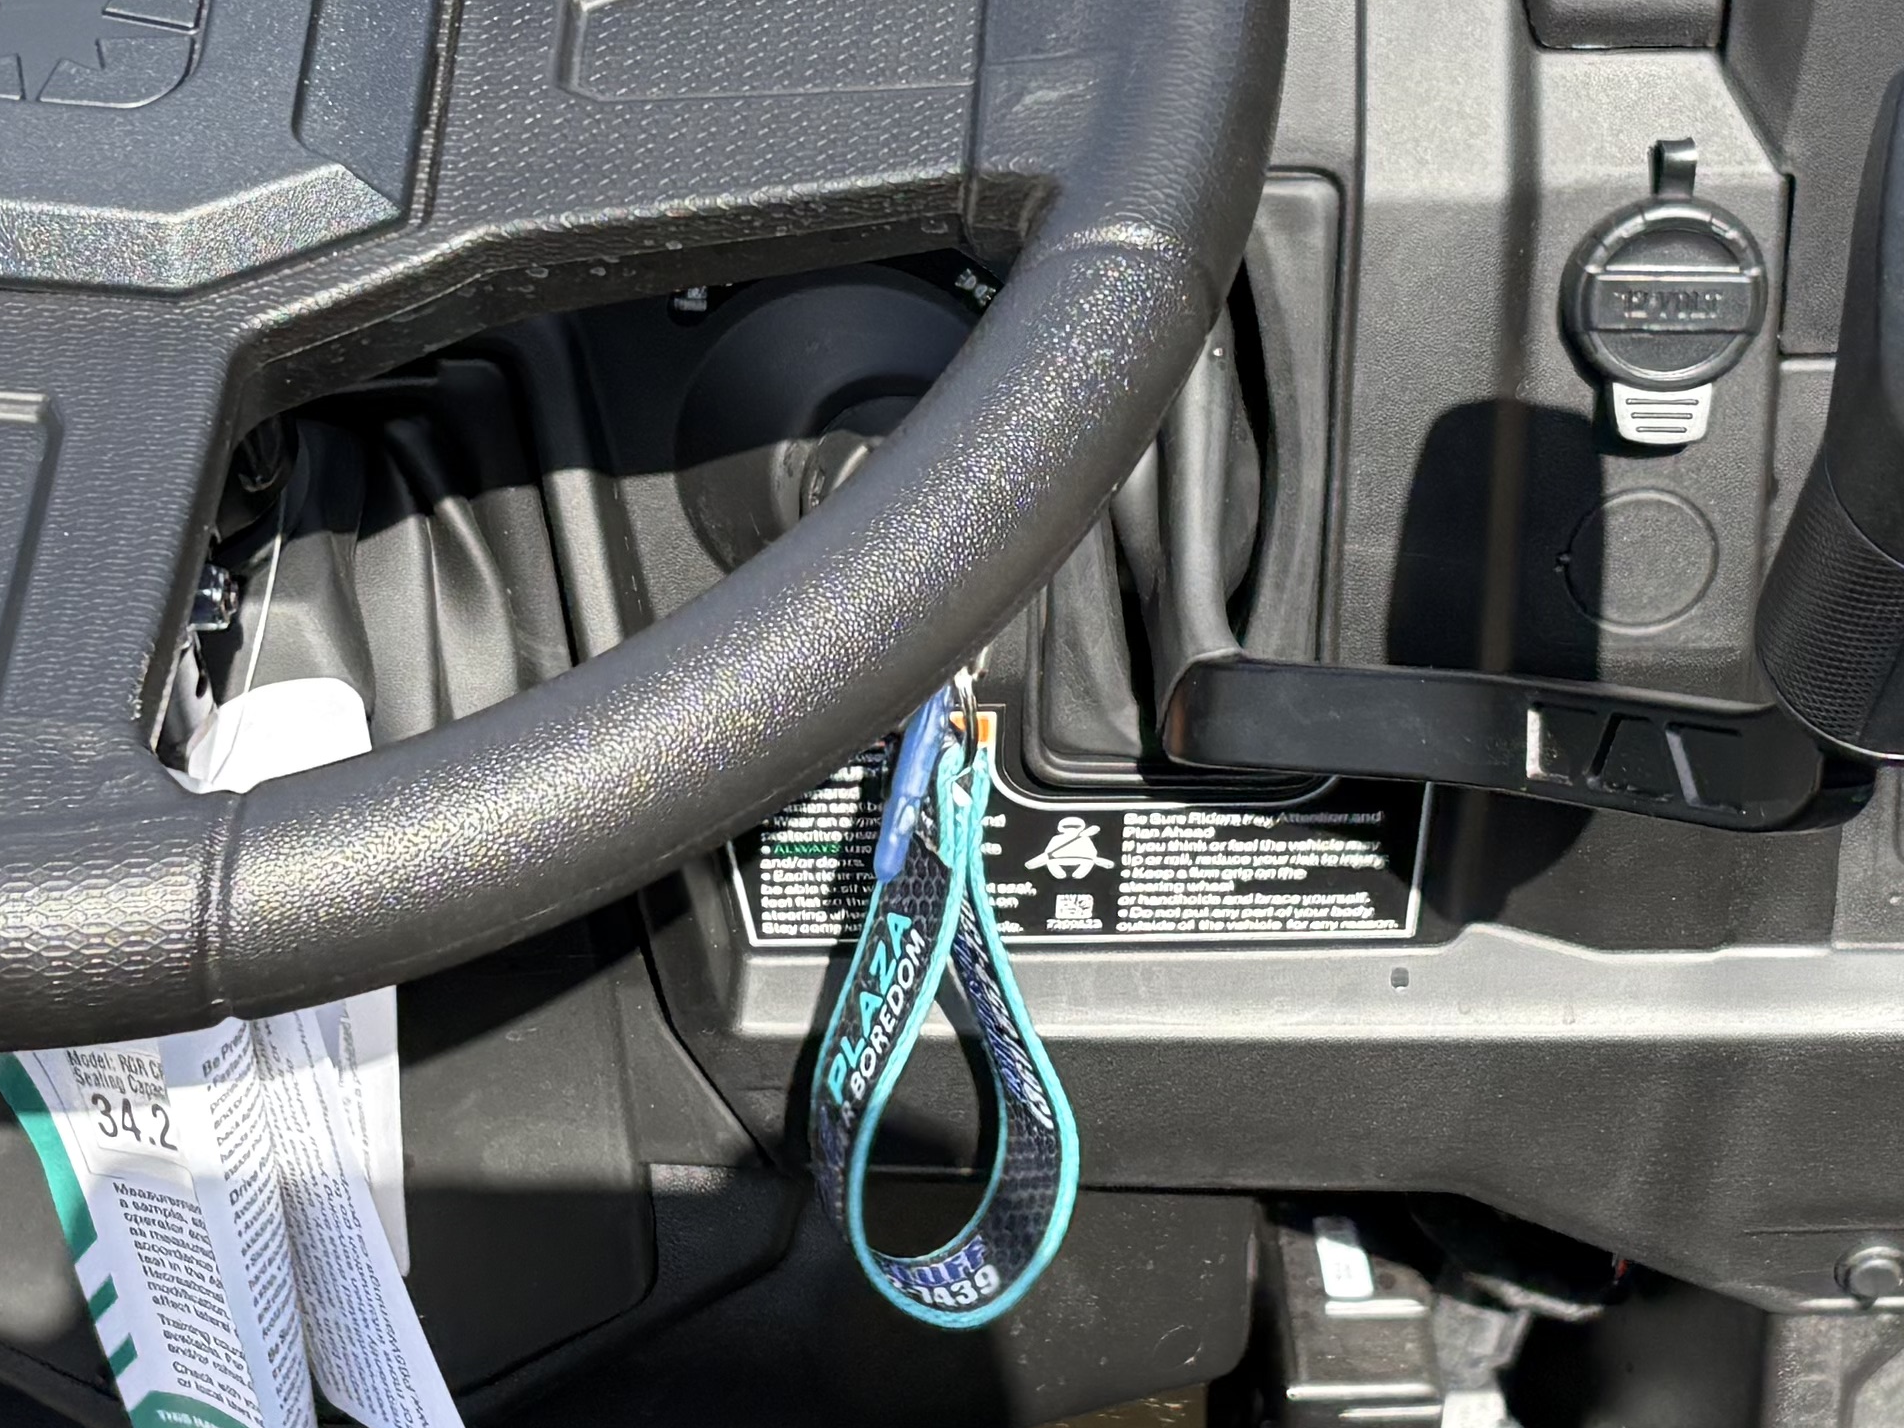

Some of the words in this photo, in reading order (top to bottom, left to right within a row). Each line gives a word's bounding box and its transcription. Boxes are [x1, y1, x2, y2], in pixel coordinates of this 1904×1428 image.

[827, 912, 912, 1106] PLAZA
[850, 928, 926, 1100] BOREDOM
[91, 1093, 179, 1152] 34.2
